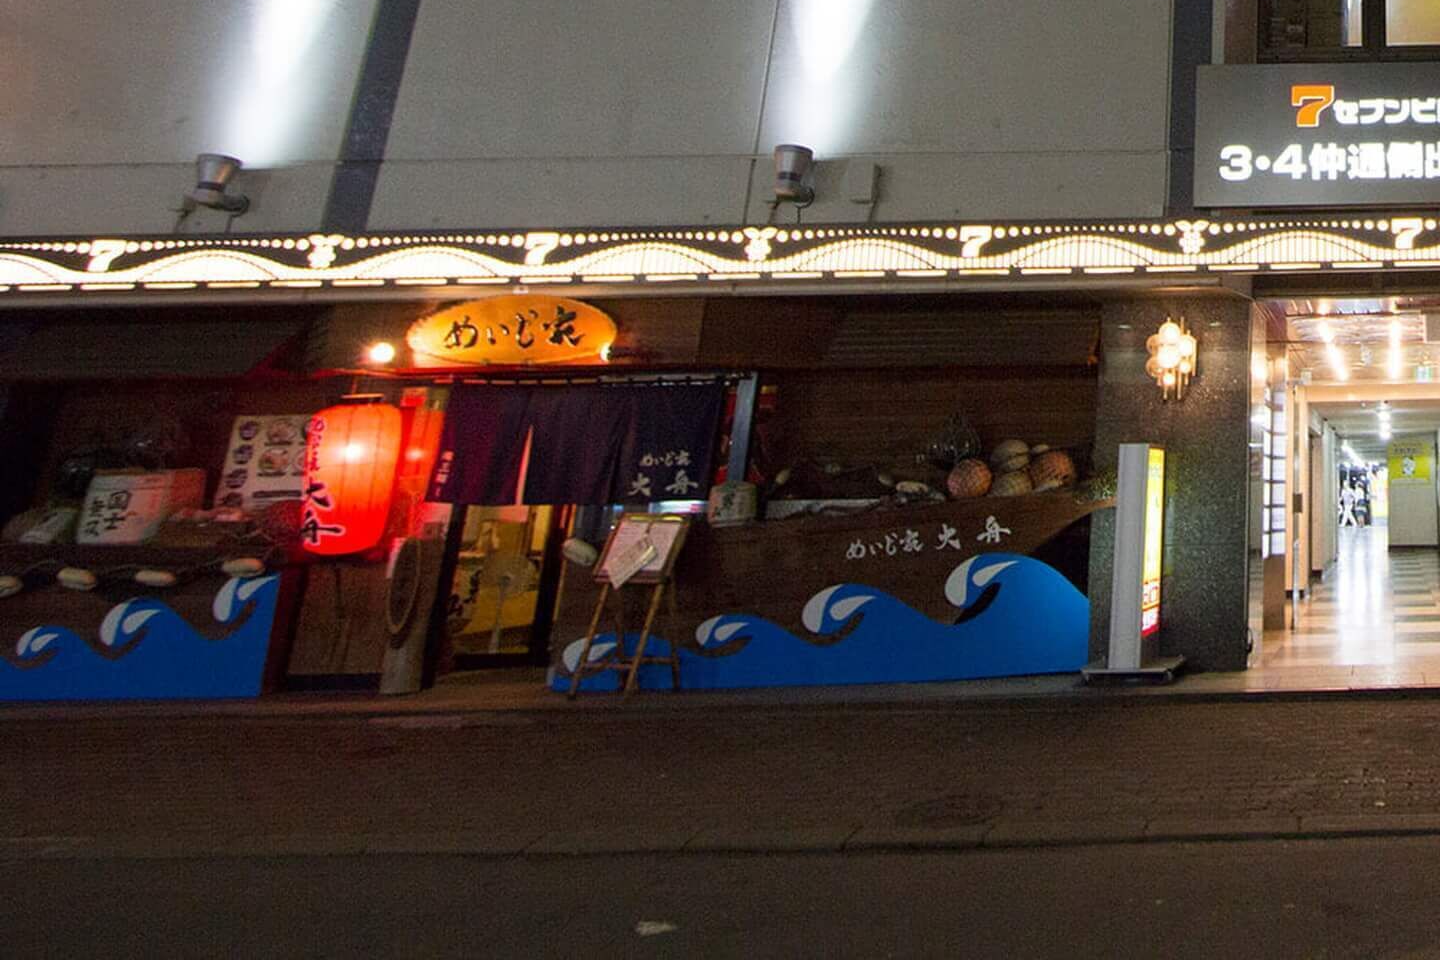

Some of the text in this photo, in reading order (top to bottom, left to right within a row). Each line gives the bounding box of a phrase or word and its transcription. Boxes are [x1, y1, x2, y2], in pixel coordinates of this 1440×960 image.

[1290, 84, 1335, 128] 7
[523, 232, 560, 265] 7
[959, 225, 992, 257] 7
[1390, 217, 1423, 249] 7
[87, 240, 127, 272] 7
